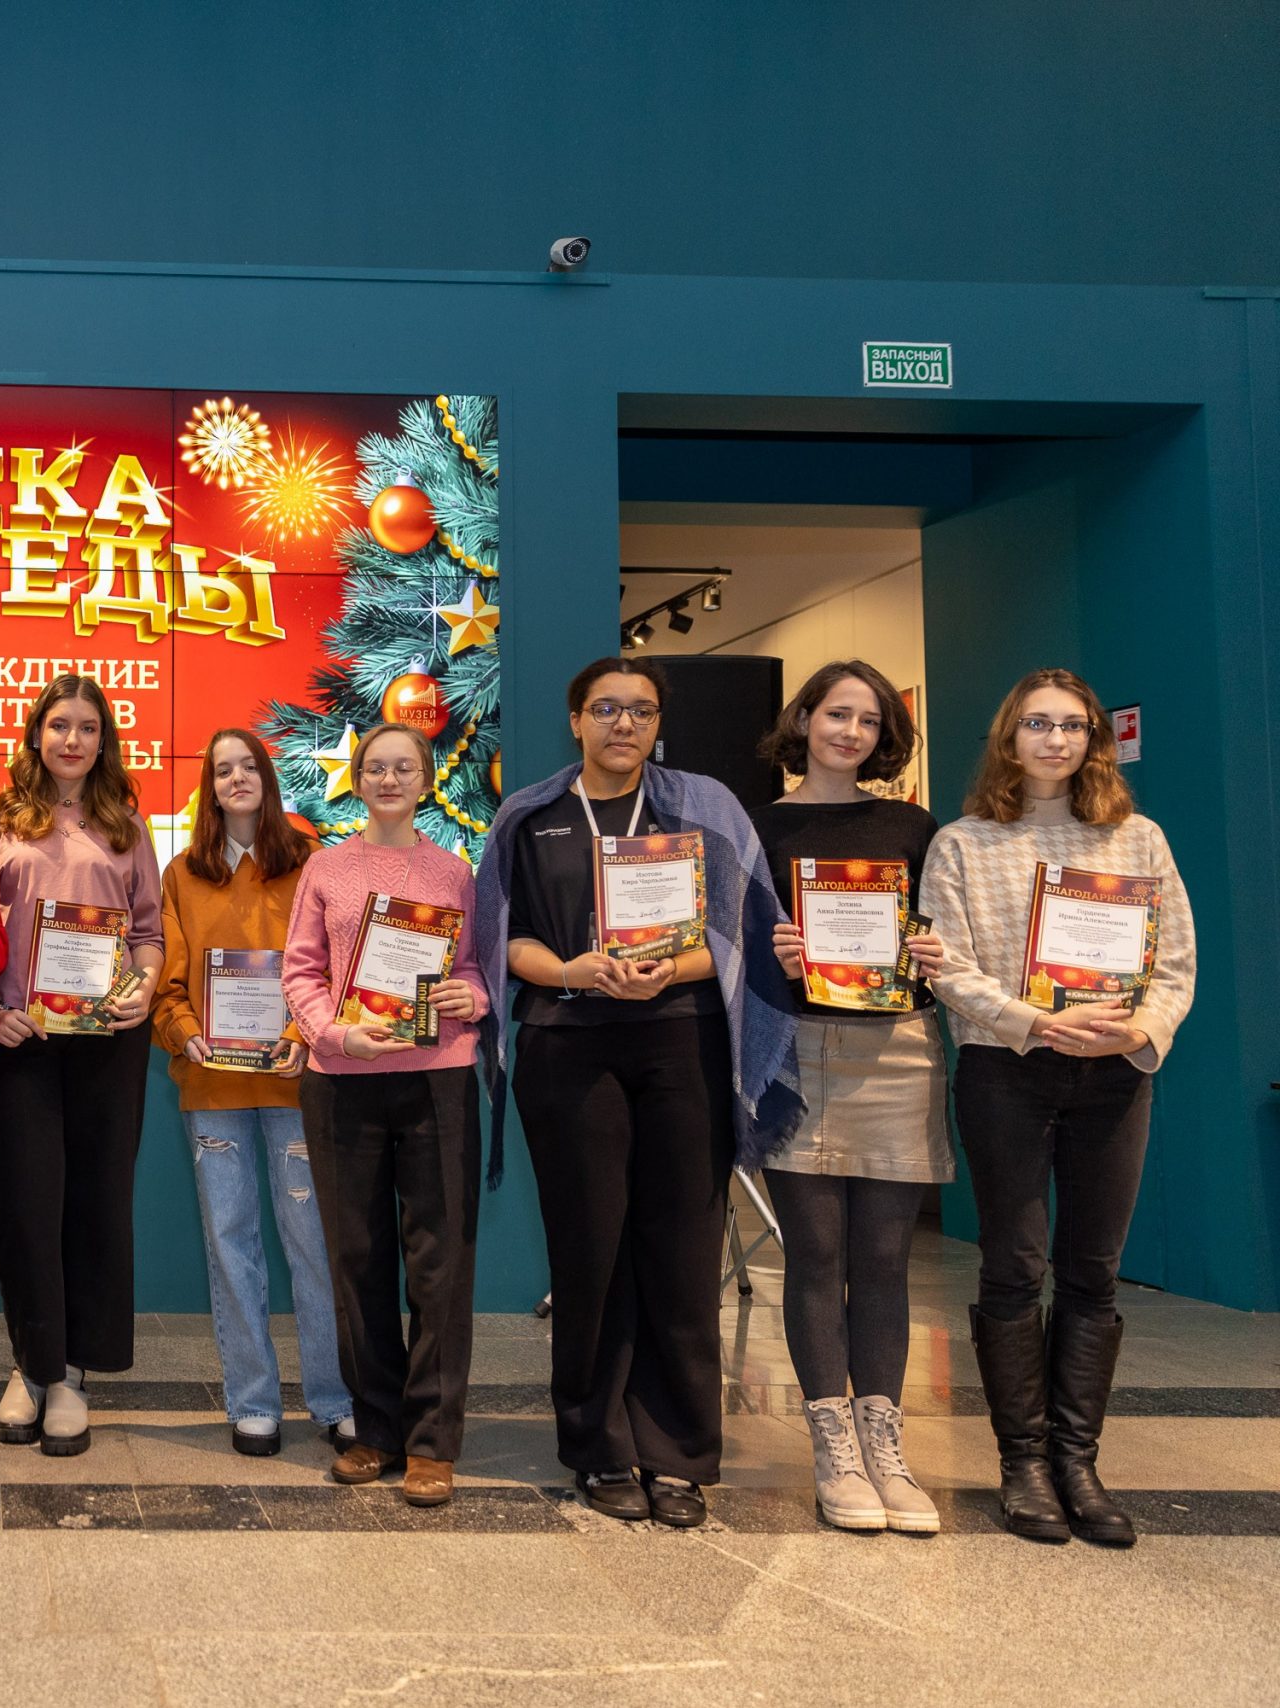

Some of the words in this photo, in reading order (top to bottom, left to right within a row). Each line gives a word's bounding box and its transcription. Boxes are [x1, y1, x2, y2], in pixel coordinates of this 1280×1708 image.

[871, 349, 942, 361] ЗАПАСНЫЙ
[871, 360, 944, 382] ВЫХОД
[399, 708, 436, 719] МУЗЕЙ
[603, 850, 694, 864] БЛАГОДАРНОСТЬ
[802, 881, 897, 891] БЛАГОДАРНОСТЬ
[1045, 884, 1148, 905] БЛАГОДАРНОСТЬ
[42, 918, 118, 935] БЛАГОДАРНОСТЬ
[371, 913, 451, 937] БЛАГОДАРНОСТЬ
[416, 982, 427, 1037] ПОКЛОНКА
[212, 1056, 263, 1067] ПОКЛОНКА
